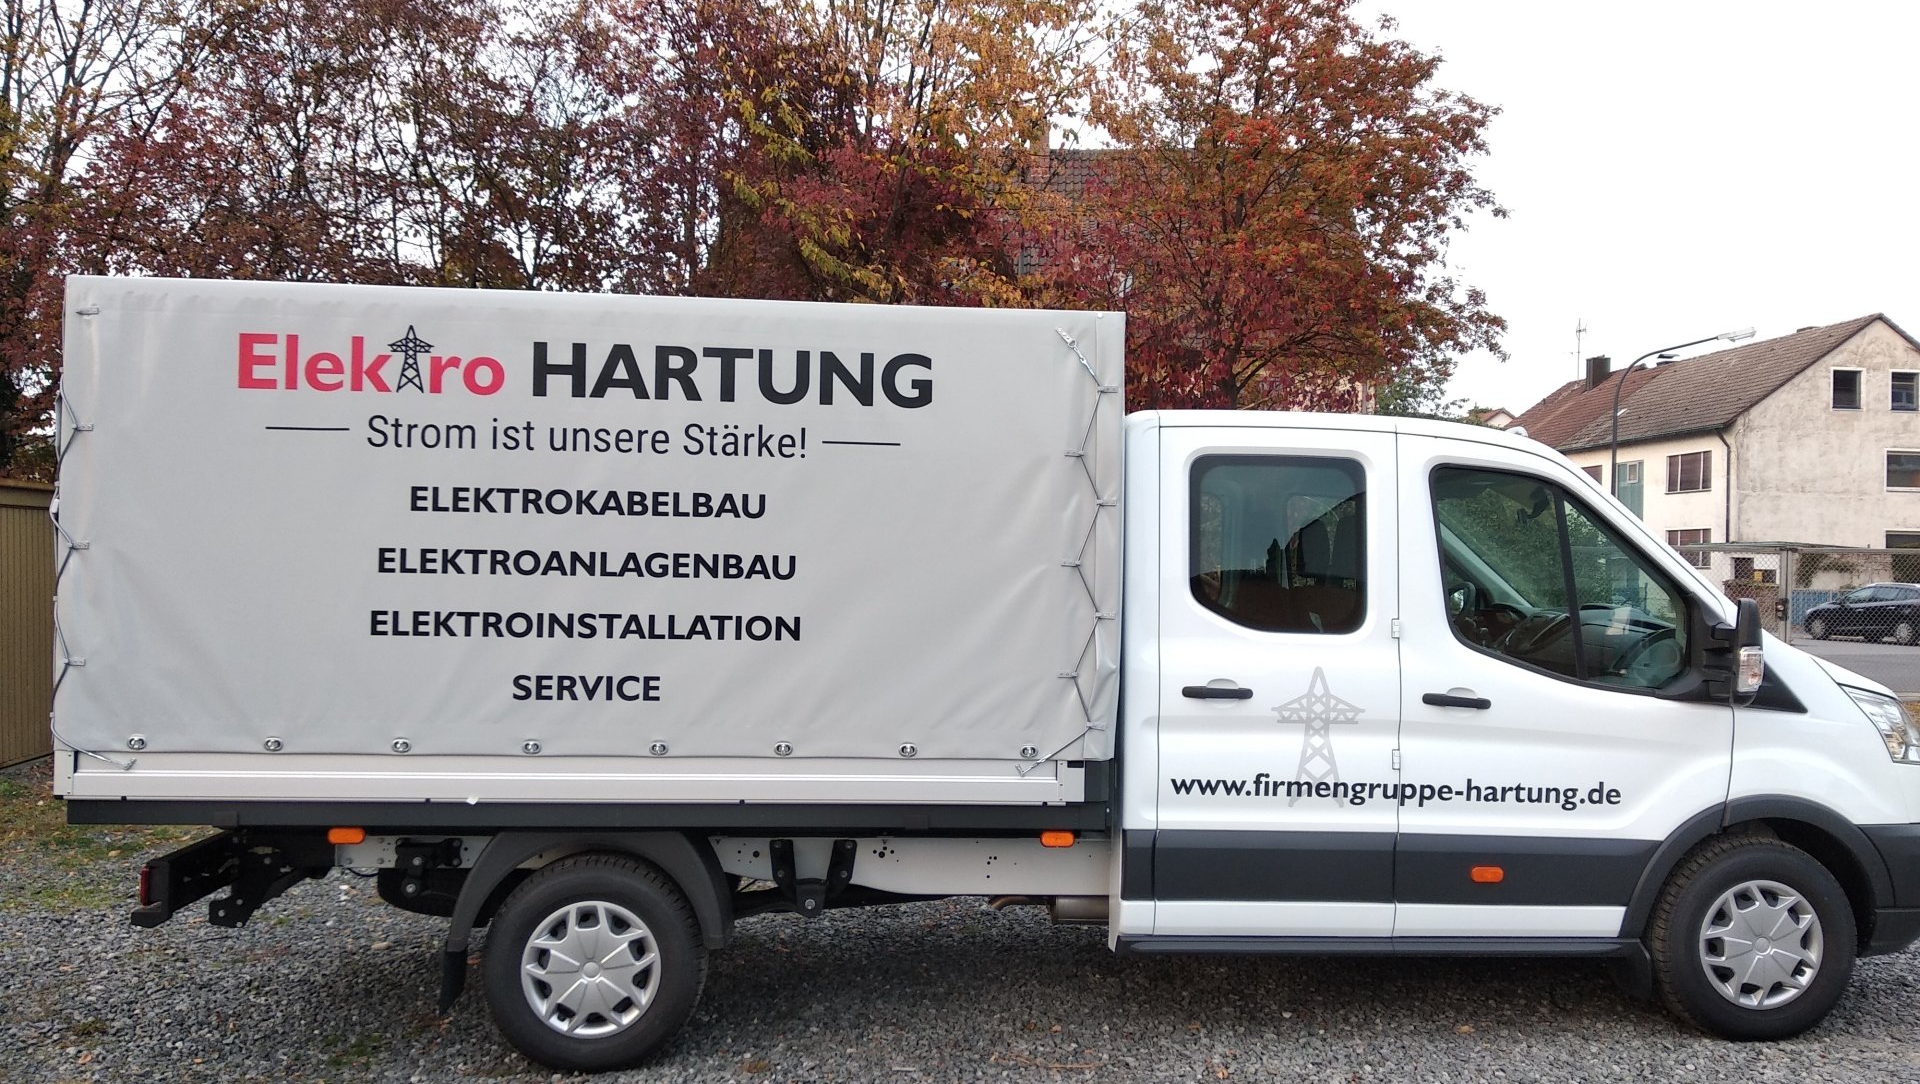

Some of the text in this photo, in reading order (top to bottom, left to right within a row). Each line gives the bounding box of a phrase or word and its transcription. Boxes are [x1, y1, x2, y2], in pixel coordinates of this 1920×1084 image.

[238, 325, 933, 409] Elektro HARTUNG
[367, 414, 807, 459] Strom ist unsere Stärke!
[410, 486, 766, 520] ELEKTROKABELBAU
[378, 548, 797, 581] ELEKTROANLAGENBAU
[371, 611, 801, 642] ELEKTROINSTALLATION
[513, 675, 661, 702] SERVICE
[1171, 773, 1621, 811] www.firmengruppe-hartung.de
